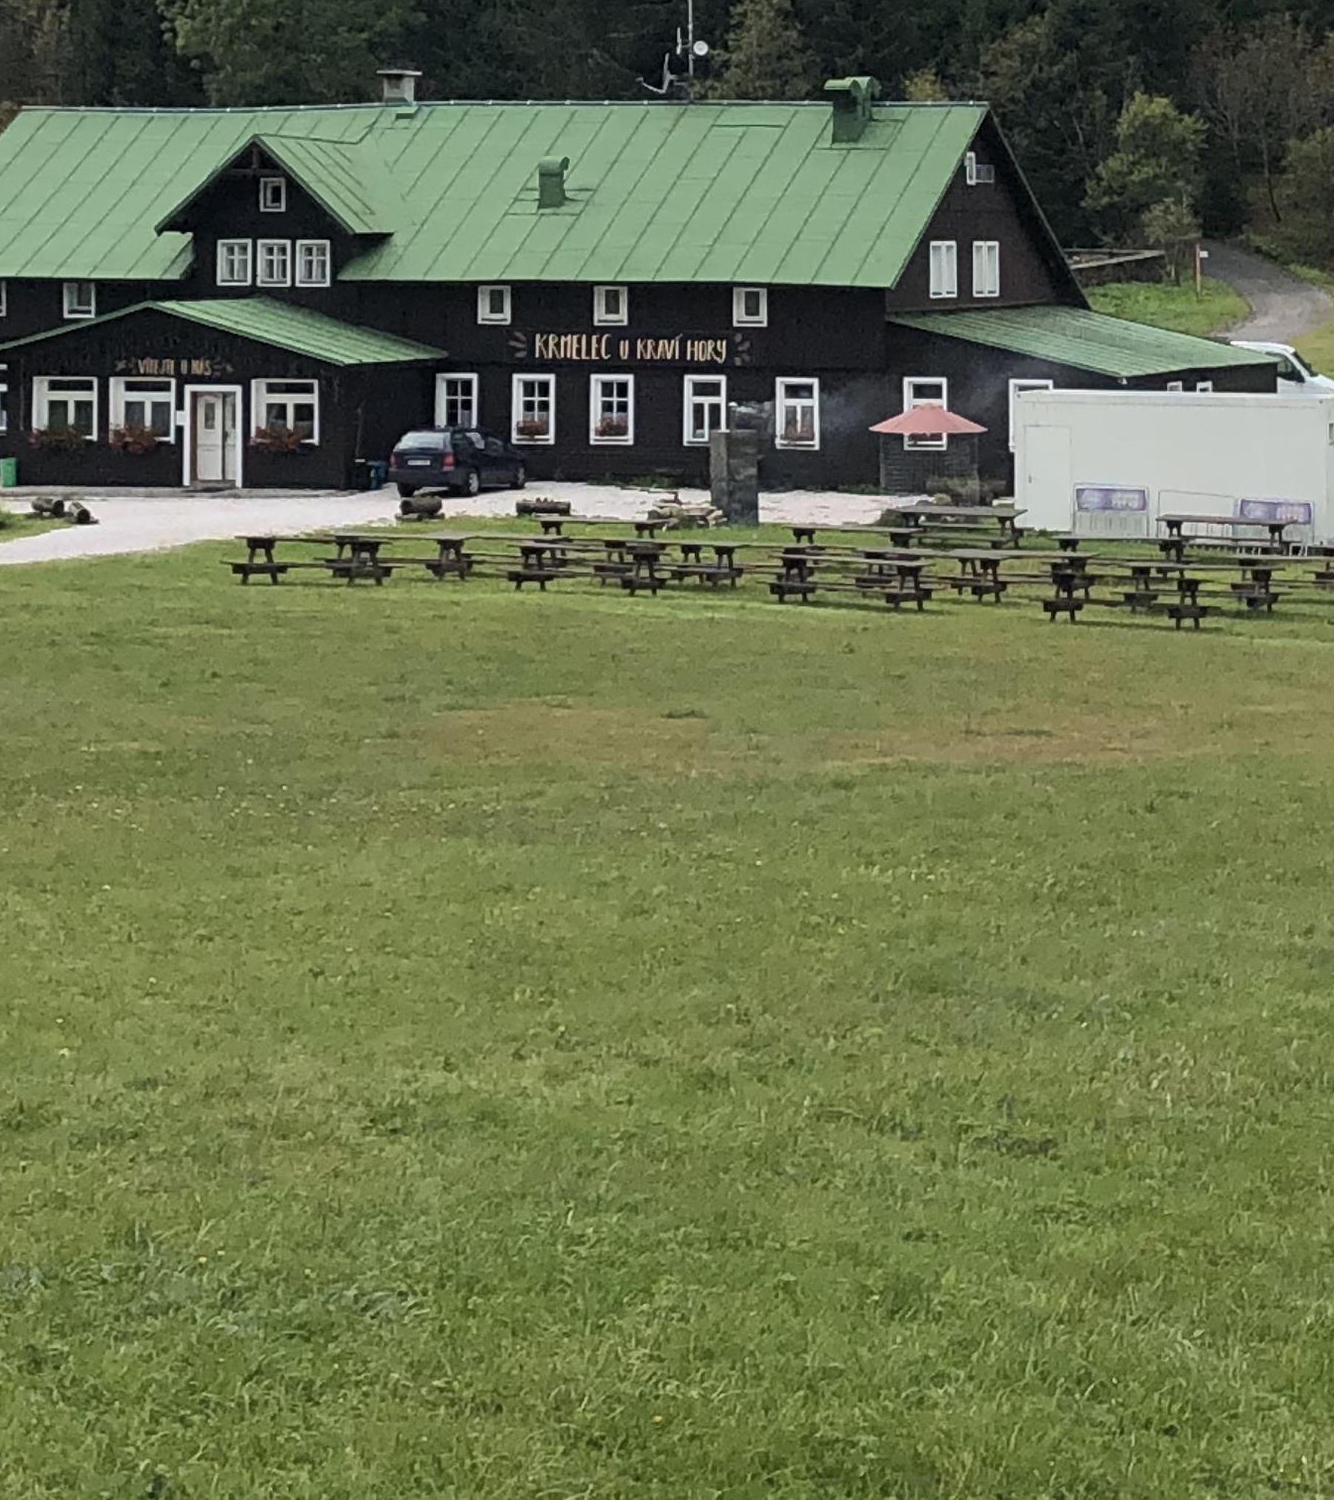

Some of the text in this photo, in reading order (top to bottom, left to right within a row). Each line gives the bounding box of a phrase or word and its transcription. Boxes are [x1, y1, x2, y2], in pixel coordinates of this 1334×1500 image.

[534, 333, 612, 360] KRMELEC
[636, 333, 683, 360] KRAVÍ
[687, 339, 727, 364] HORY
